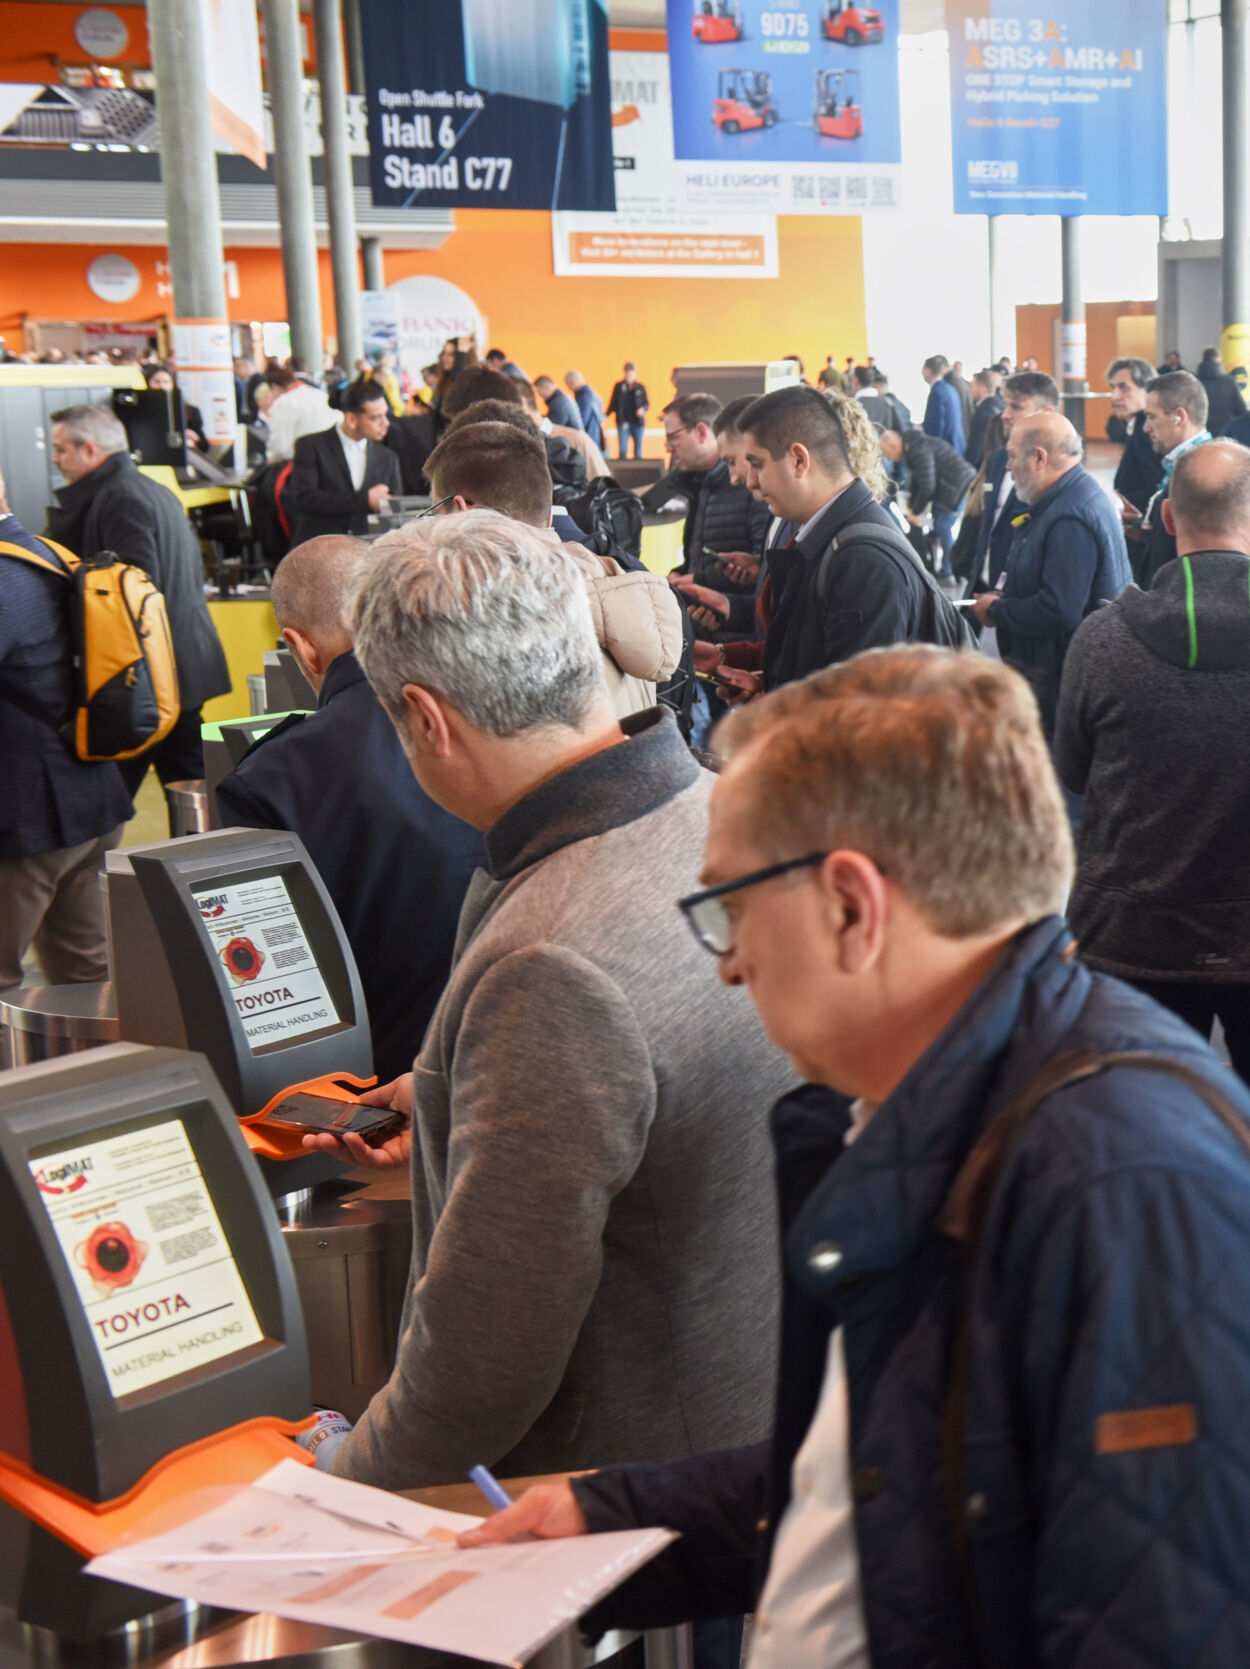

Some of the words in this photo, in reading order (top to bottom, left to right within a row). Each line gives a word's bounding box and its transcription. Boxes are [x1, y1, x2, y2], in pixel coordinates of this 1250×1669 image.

[761, 12, 809, 37] 9075
[964, 17, 1022, 42] MEG
[1028, 19, 1068, 43] 3A:
[965, 46, 1143, 71] ASRS+AMR+AI
[1110, 76, 1133, 88] and
[378, 88, 411, 109] Open
[412, 89, 454, 108] Shuttle
[455, 91, 485, 109] Fork
[381, 114, 434, 149] Hall
[438, 115, 456, 149] 6
[383, 154, 459, 190] Stand
[464, 156, 513, 191] C77
[686, 174, 719, 188] HELI
[723, 174, 780, 188] EUROPE
[235, 987, 294, 1012] TOYOTA
[245, 1020, 287, 1037] MATERIAL
[287, 1008, 328, 1027] HANDLING
[95, 1293, 191, 1338] TOYOTA
[111, 1347, 176, 1377] MATERIAL
[178, 1321, 243, 1354] HANDLING
